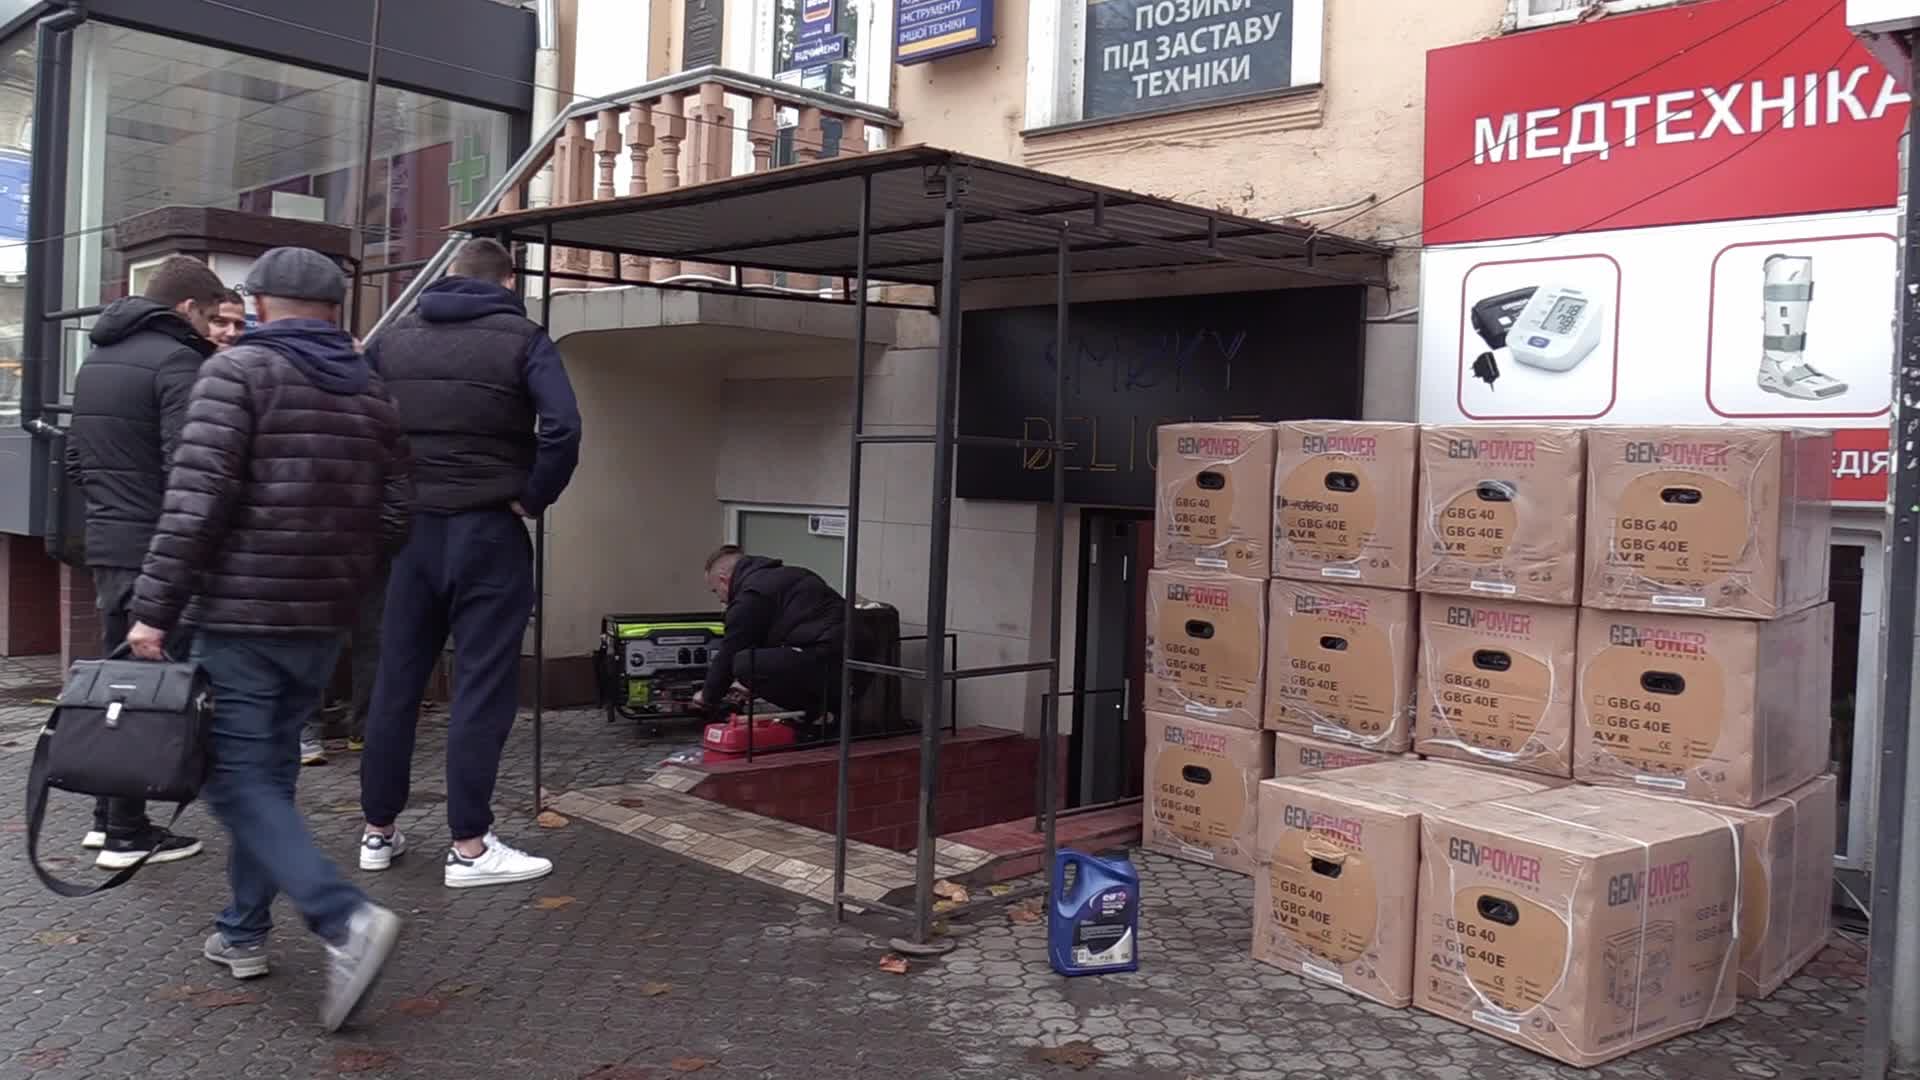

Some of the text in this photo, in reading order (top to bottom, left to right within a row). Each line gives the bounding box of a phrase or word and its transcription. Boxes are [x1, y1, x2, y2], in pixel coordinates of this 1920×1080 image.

[928, 17, 966, 35] ТЕХНІКИ
[1104, 12, 1282, 72] ПІД ЗАСТАВУ
[1132, 54, 1250, 99] ТЕХНІКИ
[1178, 437, 1240, 456] GENPOWER
[1303, 436, 1376, 456] GENPOWER
[1448, 440, 1536, 461] GENPOWER
[1625, 442, 1728, 465] GENPOWER
[1176, 498, 1210, 508] GBG 40
[1298, 502, 1338, 512] GBG 40
[1175, 513, 1216, 524] GBG 40E
[1447, 508, 1495, 520] GBG 40
[1298, 518, 1347, 530] GBG 40E
[1622, 518, 1678, 532] GBG 40
[1288, 530, 1316, 538] AVR
[1446, 526, 1504, 539] GBG 40E
[1620, 538, 1688, 552] GBG 40E
[1606, 552, 1645, 562] AVR
[1168, 584, 1229, 607] GENPOWER
[1448, 606, 1530, 634] GENPOWER
[1166, 643, 1200, 656] GBG 40
[1166, 658, 1207, 672] GBG 40E
[1291, 658, 1331, 673] GBG 40
[1291, 675, 1337, 691] GBG 40E
[1444, 673, 1490, 689] GBG 40
[1443, 691, 1499, 709] GBG 40E
[1608, 697, 1661, 713] GBG 40
[1607, 716, 1671, 733] GBG 40E
[1593, 731, 1630, 744] AVR
[1162, 783, 1195, 799] GBG 40
[1161, 798, 1201, 816] GBG 40E
[1450, 836, 1541, 884] GENPOWER
[1281, 881, 1323, 903] GBG 40
[1281, 900, 1330, 926] GBG 40E
[1446, 918, 1496, 944] GBG 40
[1445, 938, 1505, 968] GBG 40E
[1432, 953, 1466, 972] AVR
